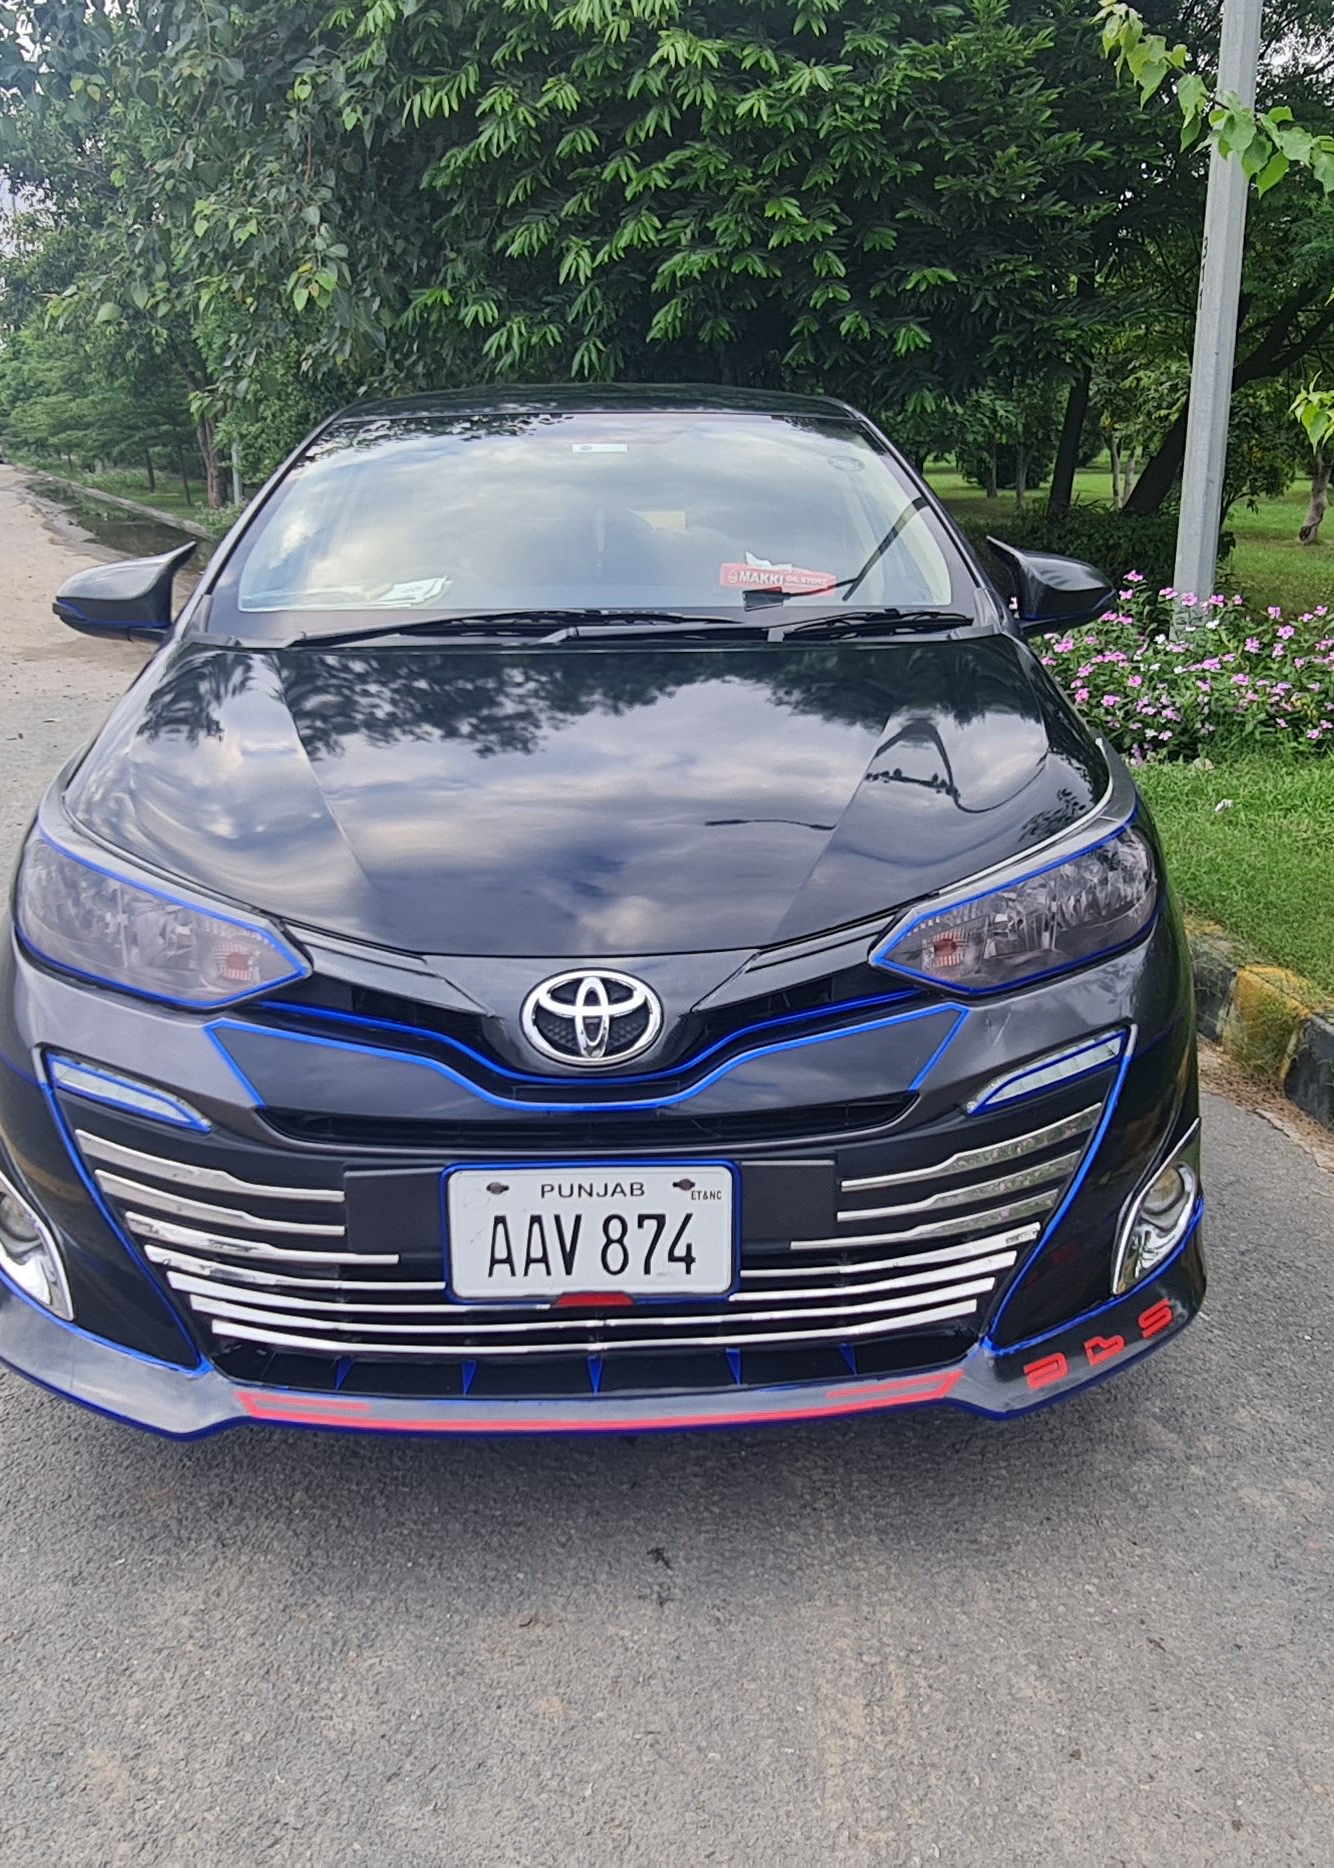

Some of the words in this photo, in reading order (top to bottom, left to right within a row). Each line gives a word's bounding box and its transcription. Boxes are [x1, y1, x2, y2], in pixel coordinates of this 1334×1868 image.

[739, 570, 784, 585] MAKKI
[540, 1182, 645, 1198] PUNJAB
[691, 1190, 722, 1200] ET&NC
[488, 1213, 582, 1278] AAV
[600, 1213, 696, 1275] 874
